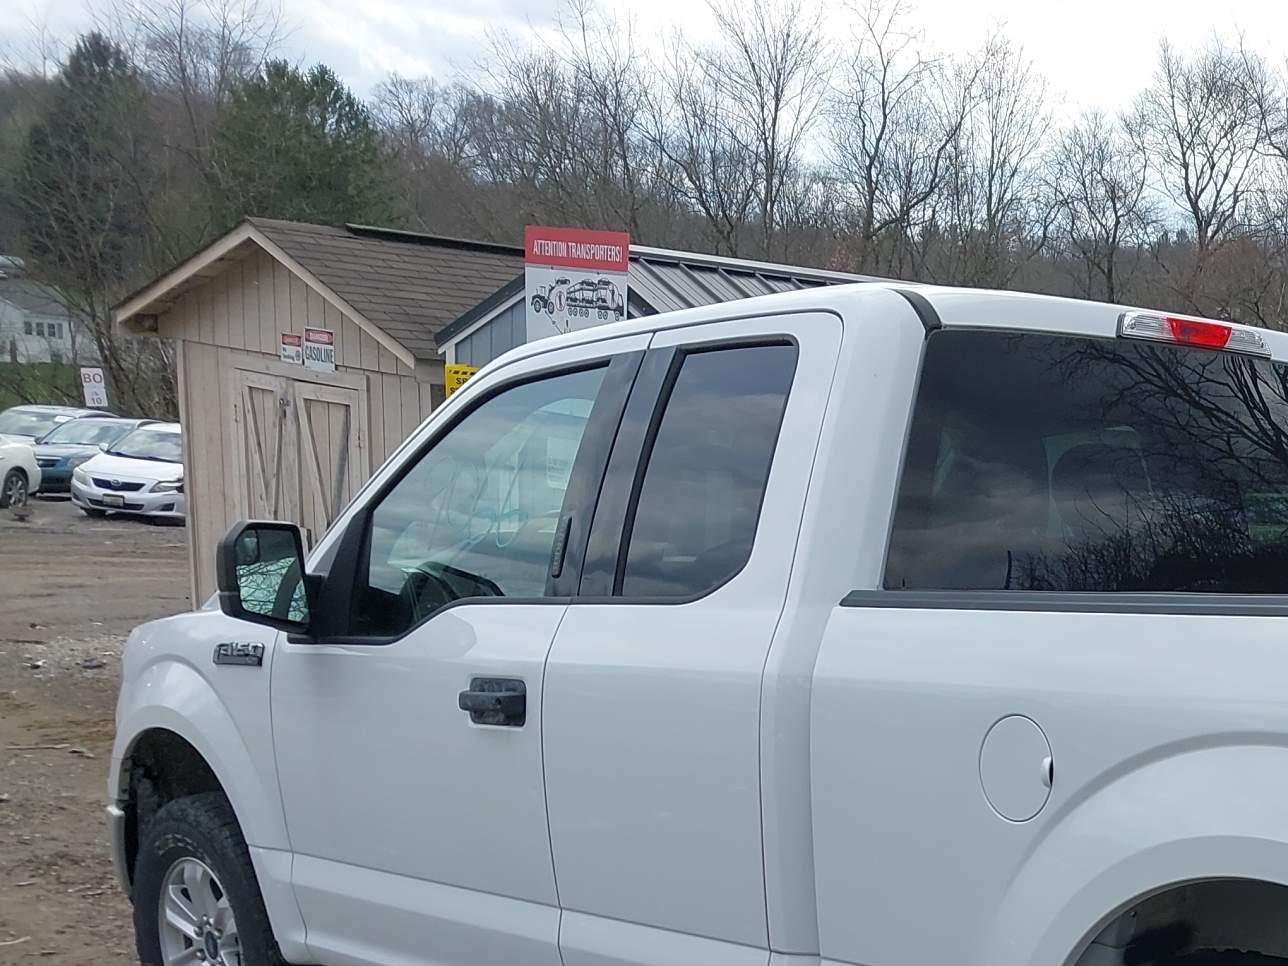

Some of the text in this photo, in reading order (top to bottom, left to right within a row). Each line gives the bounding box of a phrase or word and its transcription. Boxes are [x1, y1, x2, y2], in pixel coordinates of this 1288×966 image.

[533, 240, 623, 262] ATTENTION TRANSPORTERS!
[304, 345, 334, 364] GASOLINE
